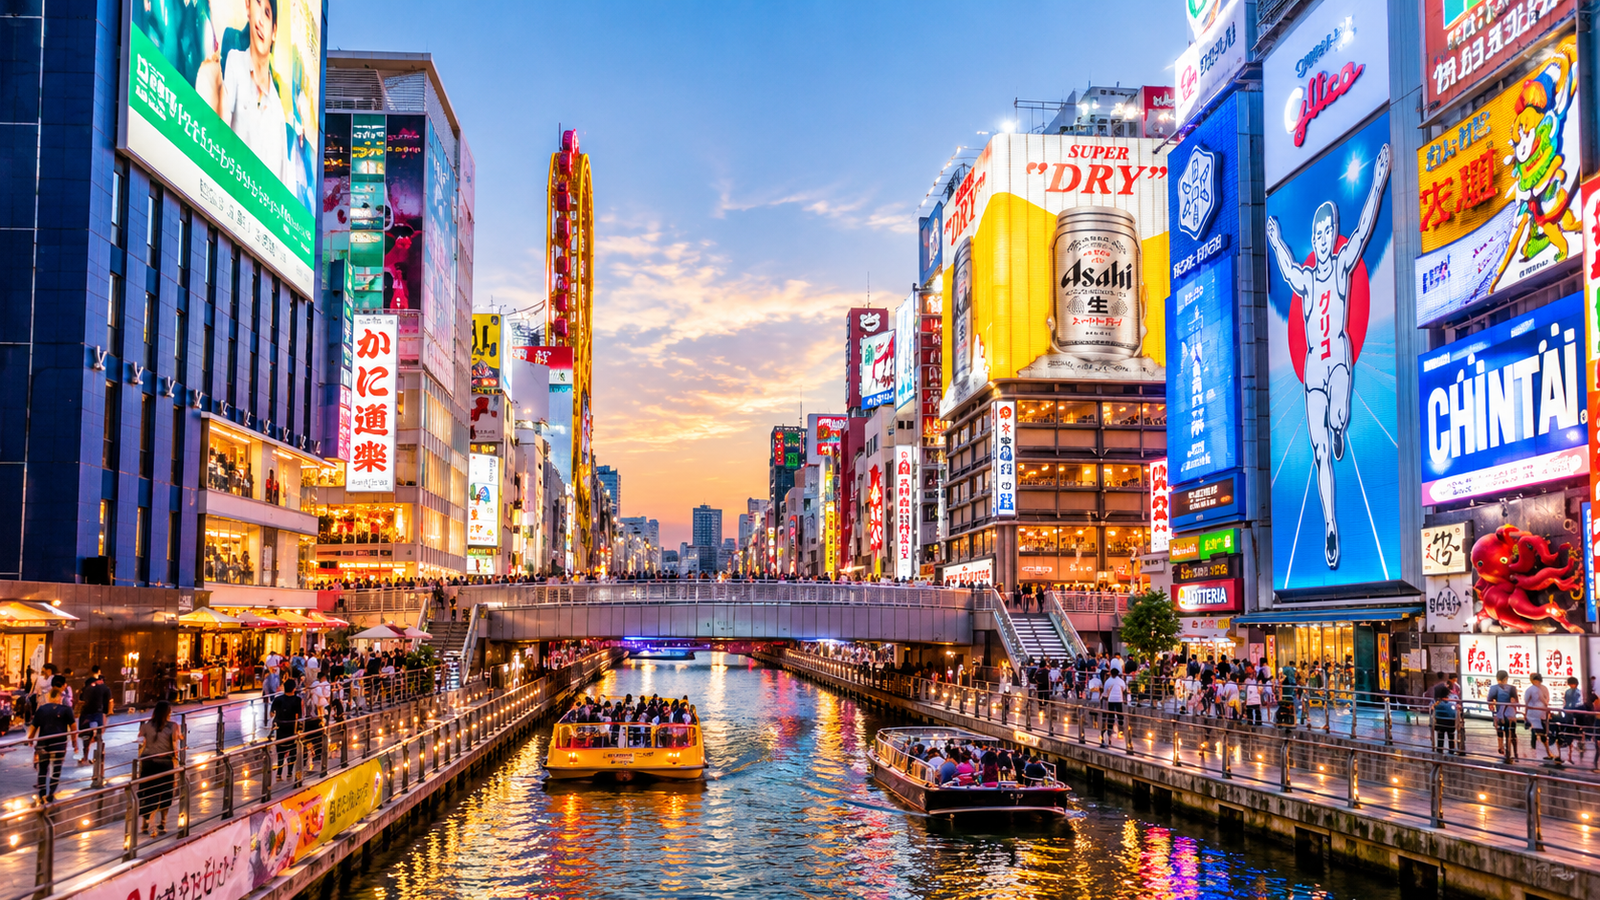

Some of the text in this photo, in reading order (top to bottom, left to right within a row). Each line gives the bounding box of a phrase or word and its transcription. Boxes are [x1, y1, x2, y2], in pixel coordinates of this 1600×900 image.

[1284, 61, 1365, 147] Glico
[1068, 144, 1130, 160] SUPER
[1061, 258, 1133, 291] Asahi
[1087, 295, 1109, 314] 生
[1319, 289, 1331, 361] グリコ
[1187, 586, 1227, 605] LOTTERIA
